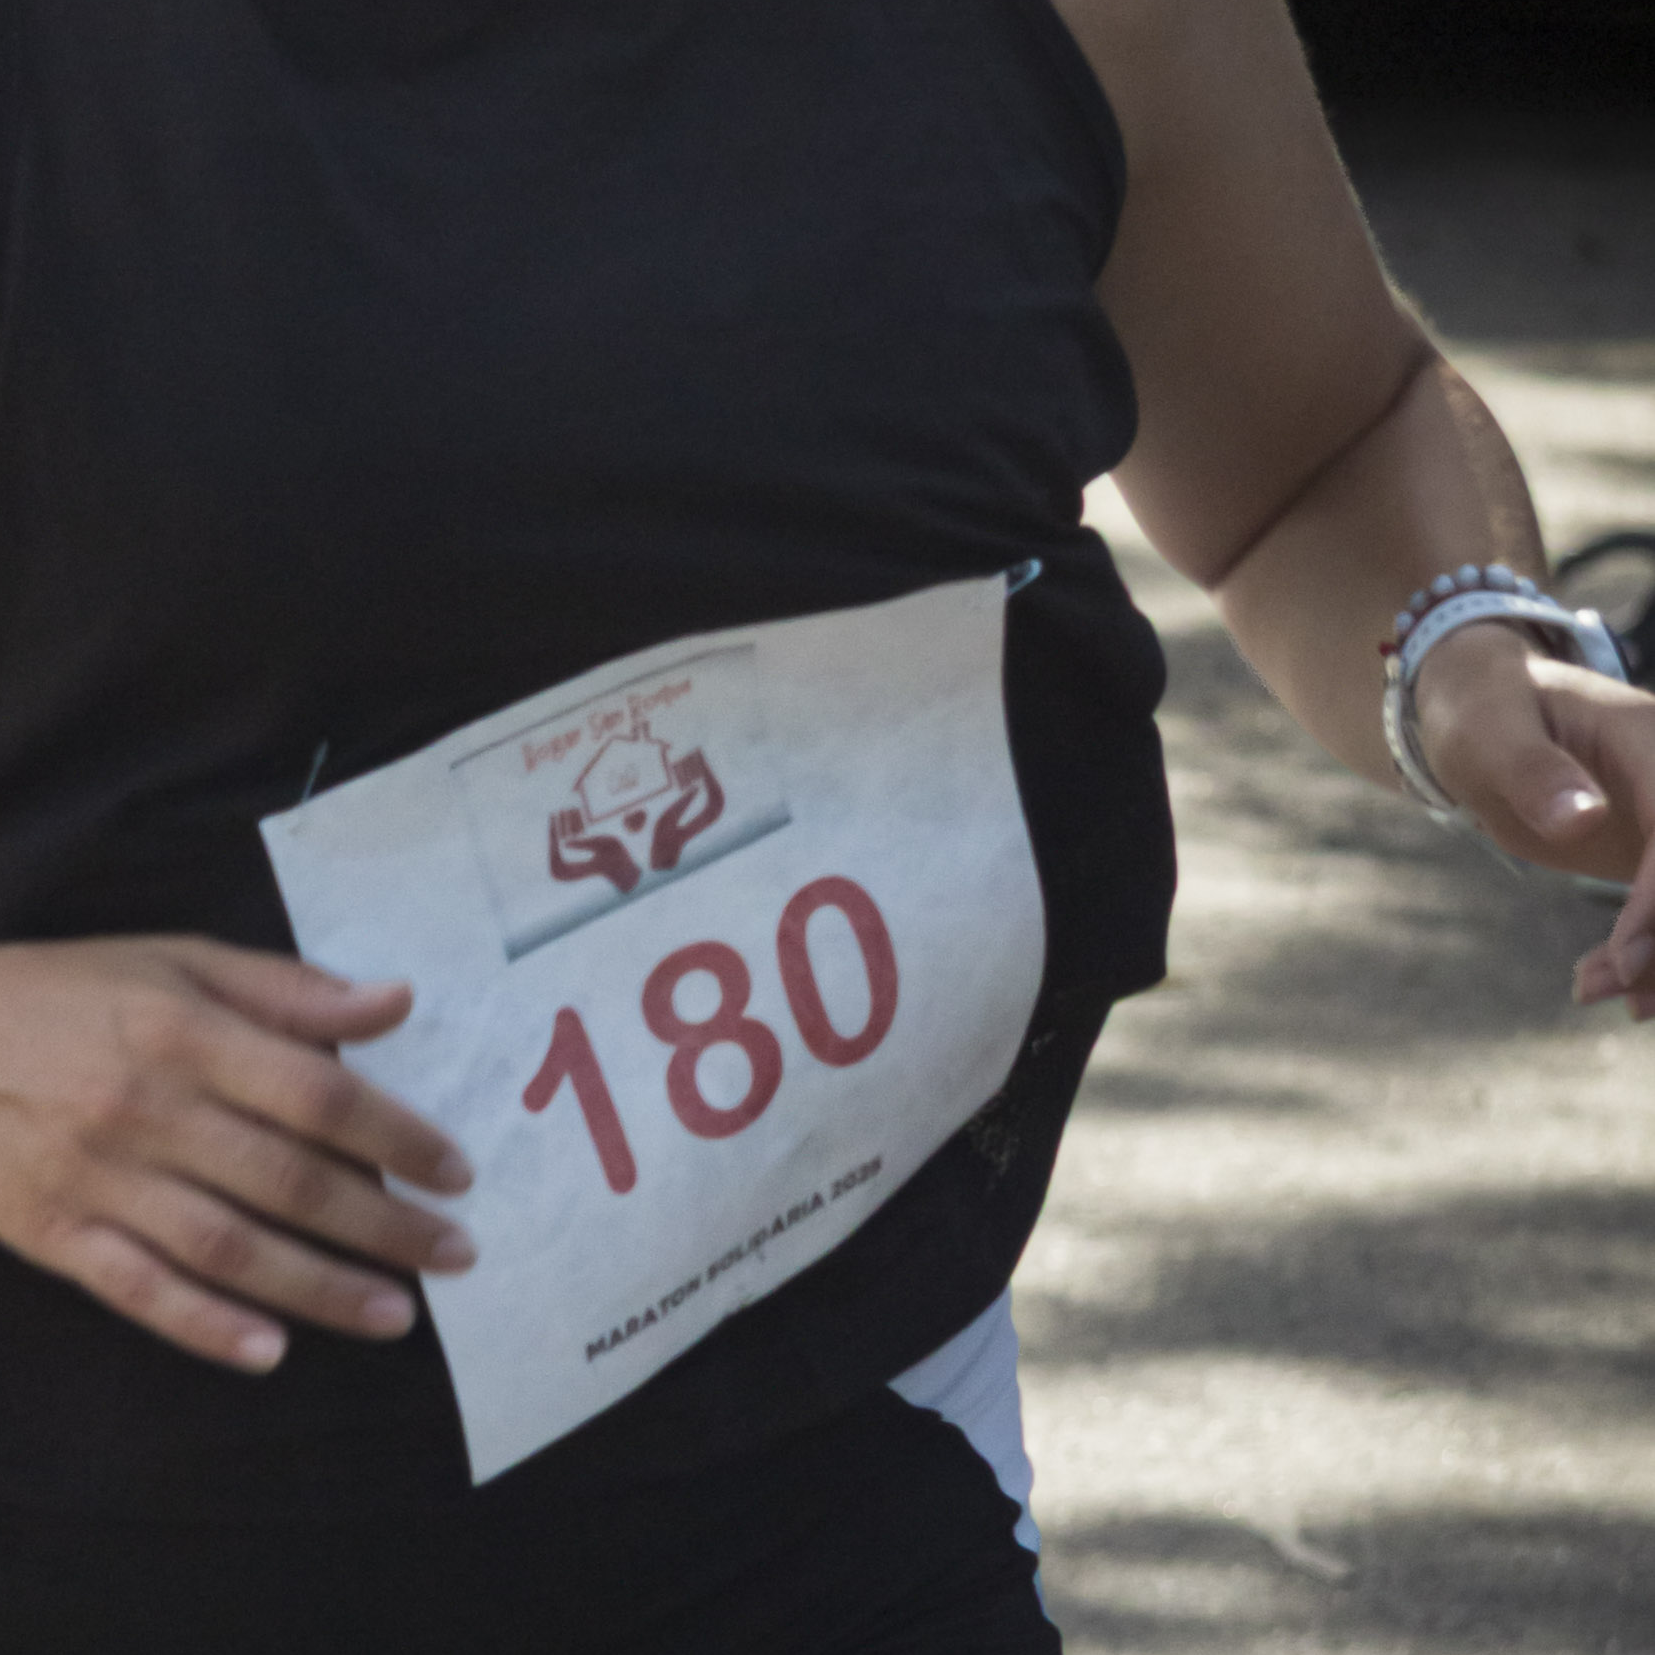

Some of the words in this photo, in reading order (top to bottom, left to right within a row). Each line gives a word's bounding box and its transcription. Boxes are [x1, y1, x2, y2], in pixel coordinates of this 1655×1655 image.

[523, 875, 899, 1194] 180
[586, 1274, 701, 1362] MARATON
[707, 1191, 824, 1282] SOLIDARIA
